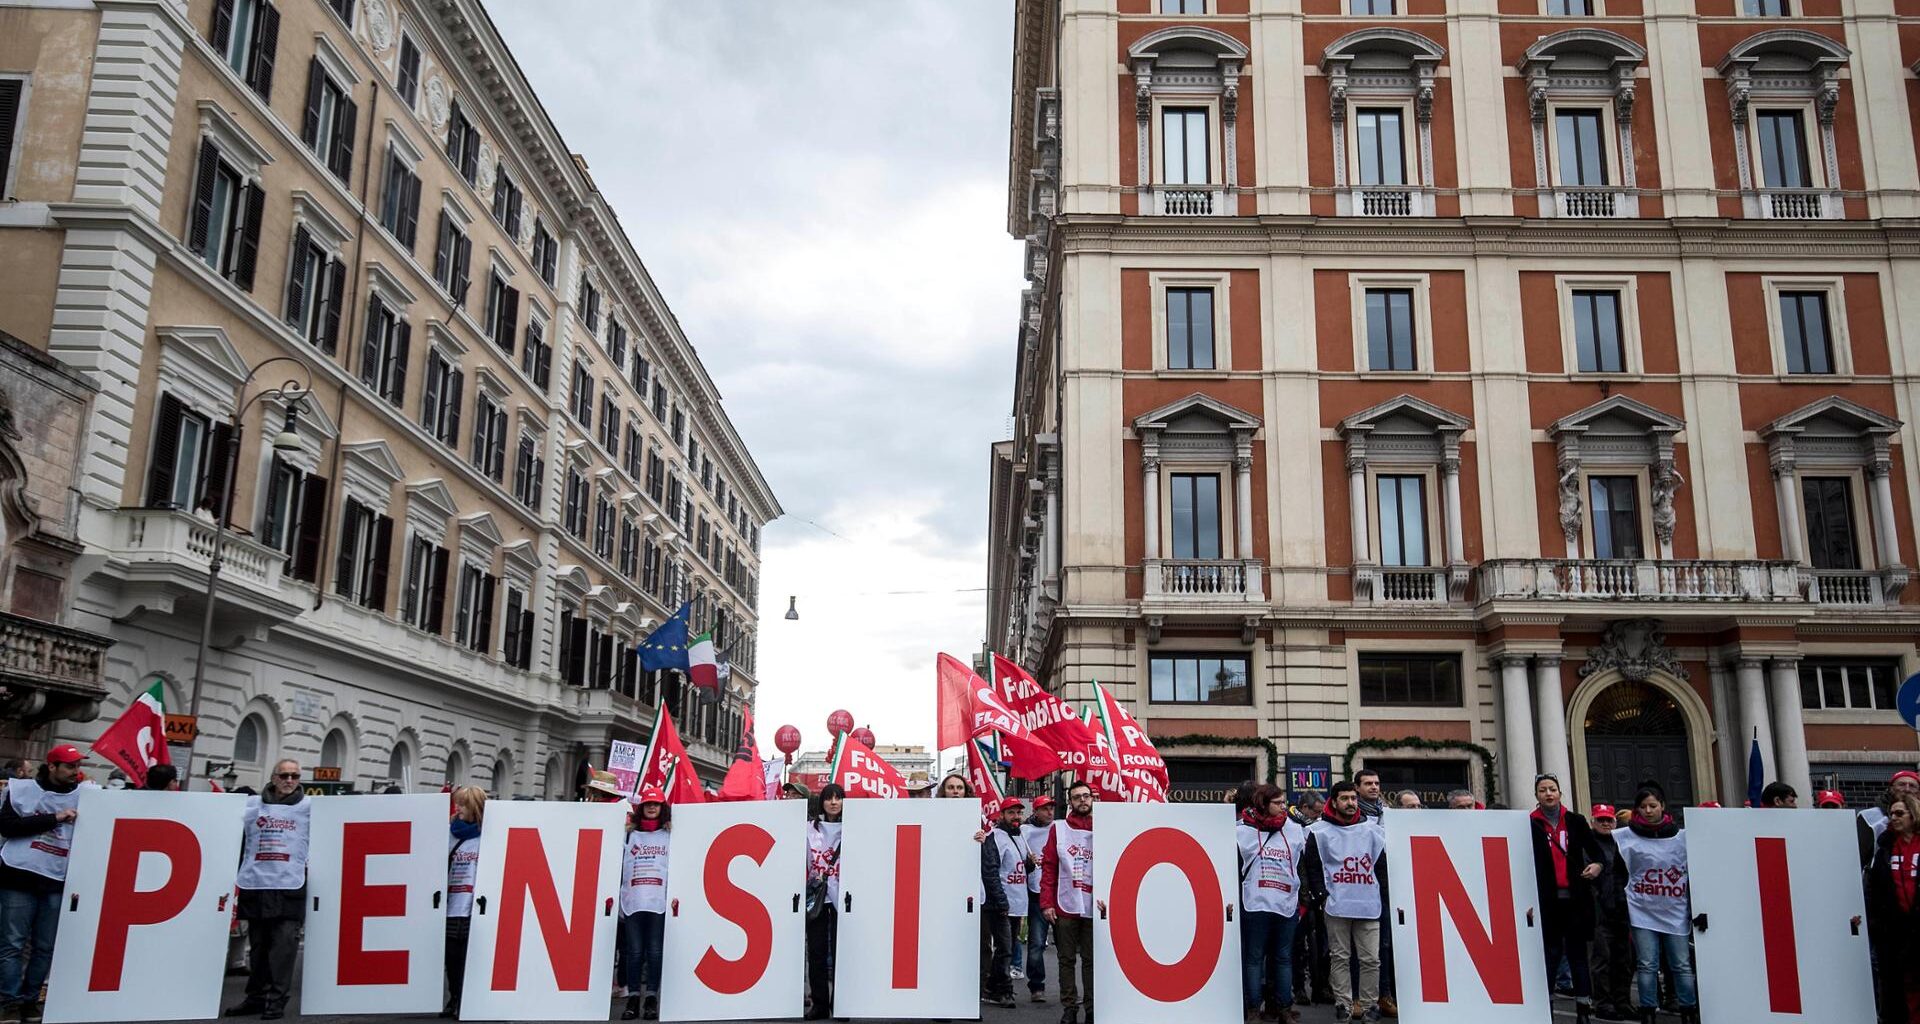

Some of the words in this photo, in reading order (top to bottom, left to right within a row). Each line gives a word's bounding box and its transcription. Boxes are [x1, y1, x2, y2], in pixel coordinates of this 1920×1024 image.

[165, 720, 193, 735] AXI
[974, 710, 1020, 734] FLAI
[1121, 725, 1155, 748] Pu
[851, 750, 885, 775] Fu
[1057, 751, 1086, 765] ZIO
[318, 768, 339, 779] TAXI
[1292, 771, 1327, 788] ENJOY
[843, 771, 899, 799] Pub
[1167, 790, 1224, 803] XQUISIT
[1344, 856, 1358, 872] Ci
[1333, 868, 1375, 885] siamo
[1644, 868, 1663, 885] Ci
[1633, 879, 1686, 897] siamo!
